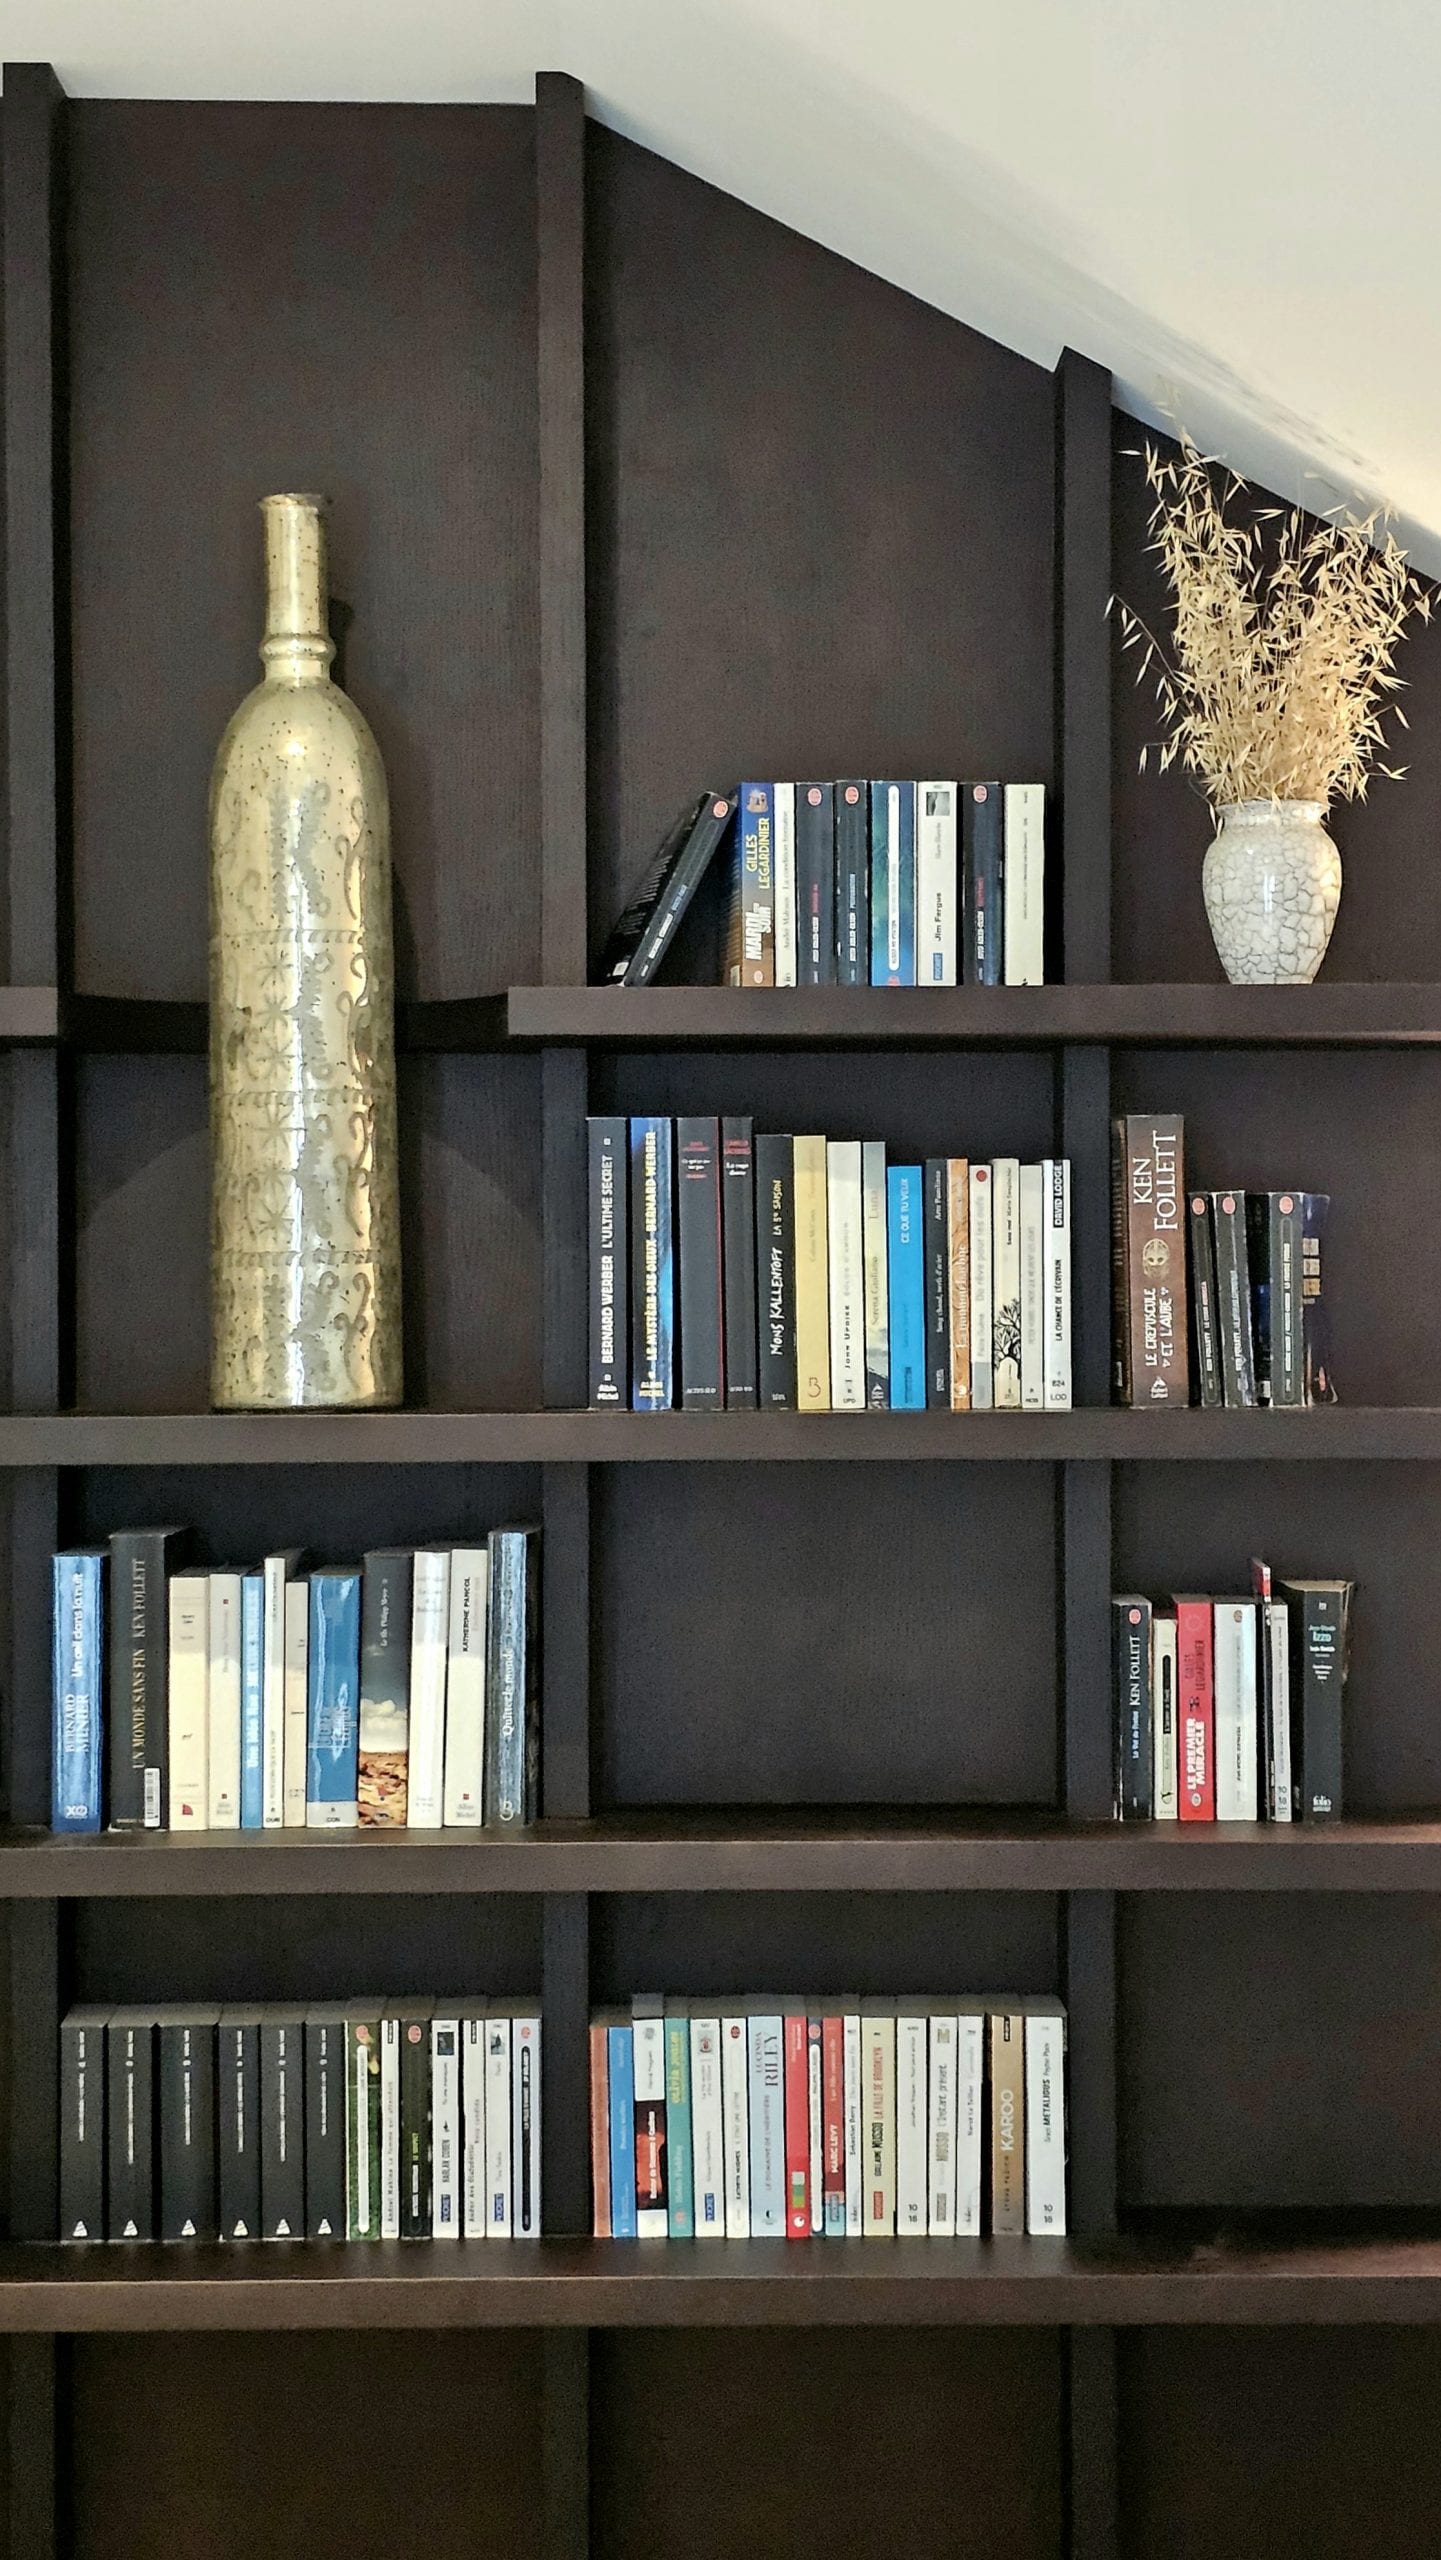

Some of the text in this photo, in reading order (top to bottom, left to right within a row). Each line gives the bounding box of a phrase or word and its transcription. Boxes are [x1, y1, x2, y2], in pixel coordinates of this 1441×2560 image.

[746, 834, 758, 872] GILLES
[758, 817, 770, 889] LEGARDINIER
[745, 911, 762, 960] MARDI
[934, 892, 943, 942] Jim Fergus
[645, 1132, 656, 1177] WERBER
[772, 1180, 782, 1210] SAISON
[1054, 1165, 1063, 1226] DAVID LODGE
[1133, 1158, 1152, 1204] KEN
[1152, 1130, 1178, 1230] FOLLETT
[646, 1178, 656, 1232] BERNARD
[869, 1190, 879, 1220] Luna
[901, 1178, 910, 1243] CE QUE TU VEUX
[772, 1225, 782, 1236] LA
[601, 1155, 614, 1364] BERNARD WERBER L'ULTIME SECRET
[646, 1239, 657, 1271] DIEUX
[646, 1273, 657, 1293] DES
[770, 1246, 785, 1319] KALLENTOFT
[1054, 1296, 1063, 1304] DE
[1054, 1306, 1063, 1331] CHANCE
[1054, 1333, 1063, 1342] LA
[1159, 1298, 1173, 1357] ET L'AUBE
[646, 1344, 657, 1360] LE
[1145, 1353, 1158, 1366] LE
[72, 1573, 84, 1598] nuit
[72, 1600, 84, 1612] la
[462, 1577, 470, 1652] KATHERINE PANCOL
[72, 1614, 84, 1639] dans
[72, 1662, 84, 1677] Un
[132, 1558, 146, 1768] UN MONDE SANS FIN KEN FOLLETT
[502, 1648, 514, 1684] monde
[1129, 1635, 1140, 1706] KEN FOLLETT
[65, 1694, 76, 1752] BERNARD
[76, 1694, 89, 1752] MINIER
[502, 1696, 514, 1736] Quitter
[1186, 1718, 1196, 1790] LE PREMIER
[1196, 1722, 1205, 1785] MIRACLE
[764, 2034, 778, 2087] RILEY
[873, 2046, 884, 2080] BROOKLYN
[873, 2082, 884, 2091] DE
[873, 2093, 884, 2110] FILLE
[872, 2122, 884, 2149] MUSSO
[1000, 2088, 1014, 2151] KAROO
[830, 2124, 838, 2173] MARC LEVY
[908, 2204, 918, 2212] 10
[1044, 2204, 1053, 2212] 10
